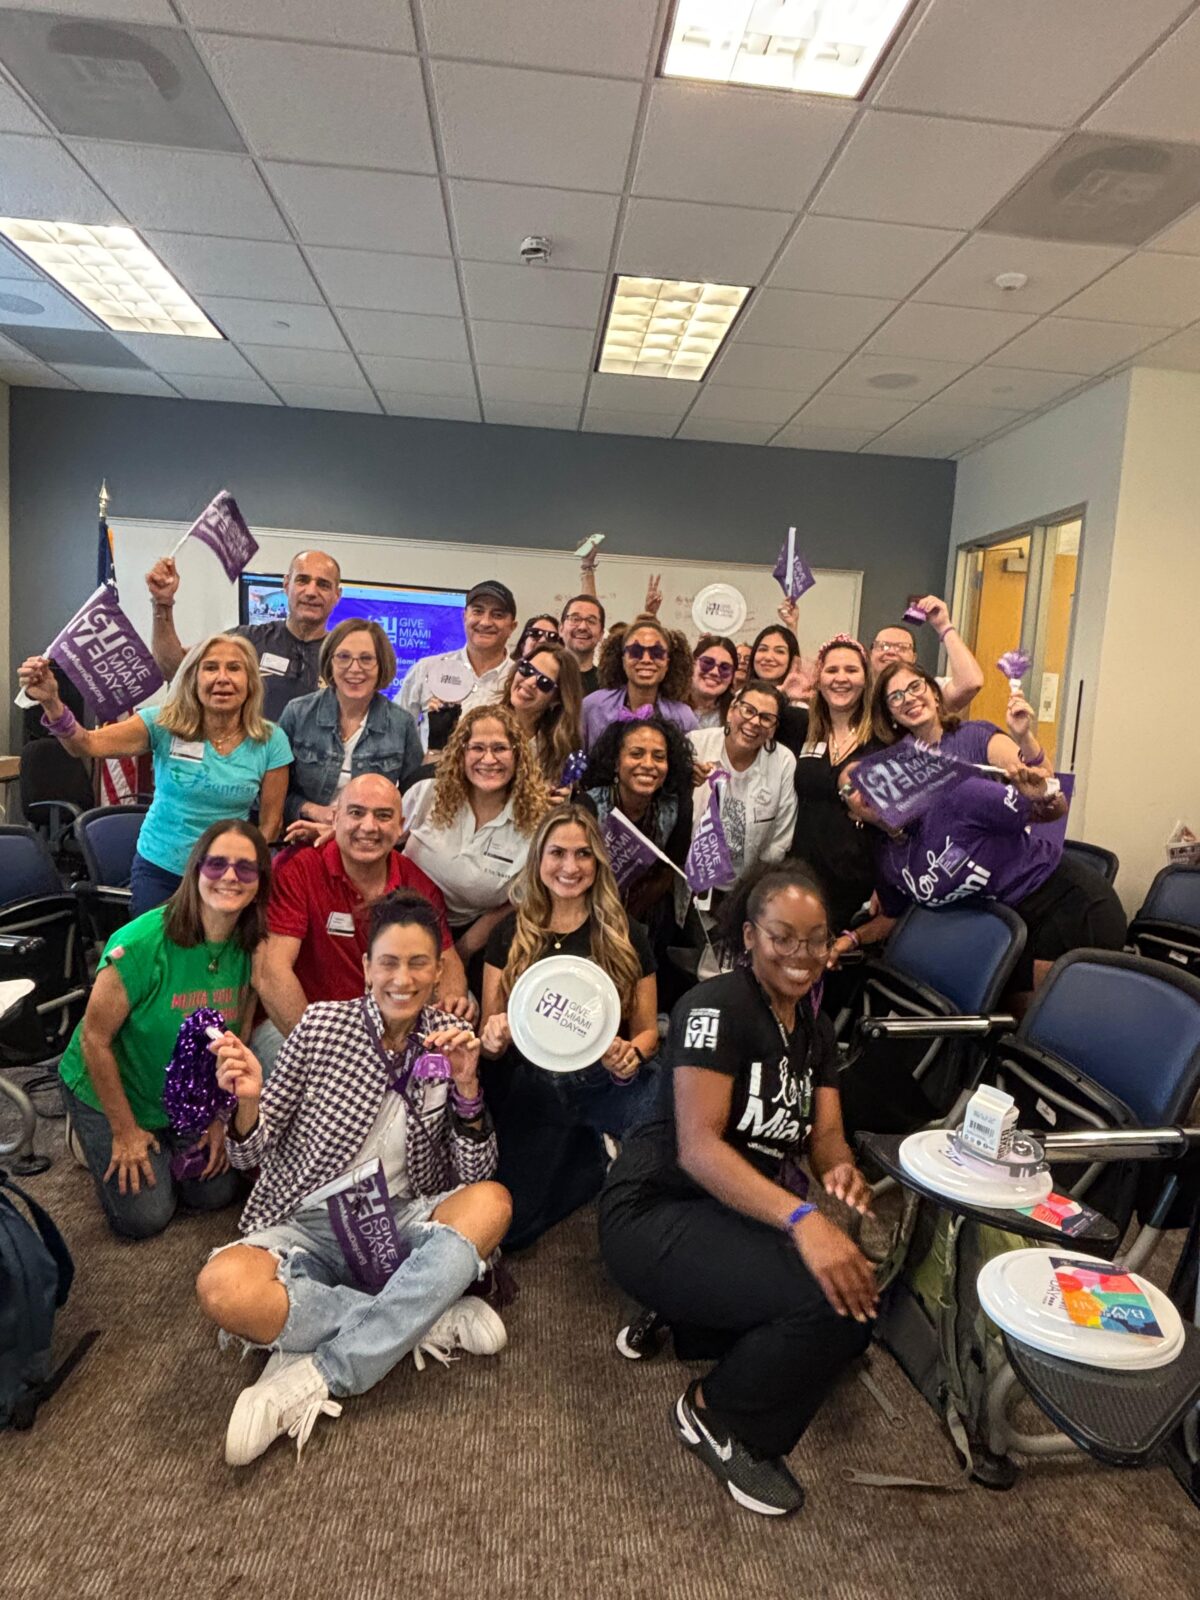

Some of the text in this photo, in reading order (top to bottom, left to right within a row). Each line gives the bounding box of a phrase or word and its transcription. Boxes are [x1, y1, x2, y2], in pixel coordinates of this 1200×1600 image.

[399, 617, 425, 628] GIVE
[399, 628, 432, 639] MIAMI
[399, 638, 420, 648] DAY
[93, 660, 123, 690] DAY
[107, 652, 144, 698] MIAMI
[121, 645, 151, 681] GIVE
[913, 761, 943, 784] DAY
[611, 850, 630, 873] DAY
[693, 840, 705, 868] DAY
[700, 836, 716, 879] MIAMI
[708, 832, 721, 865] GIVE
[564, 1009, 592, 1031] MIAMI
[568, 1001, 591, 1018] GIVE
[560, 1018, 578, 1033] DAY
[359, 1222, 379, 1256] DAY
[372, 1220, 394, 1273] MIAMI
[379, 1216, 398, 1260] GIVE
